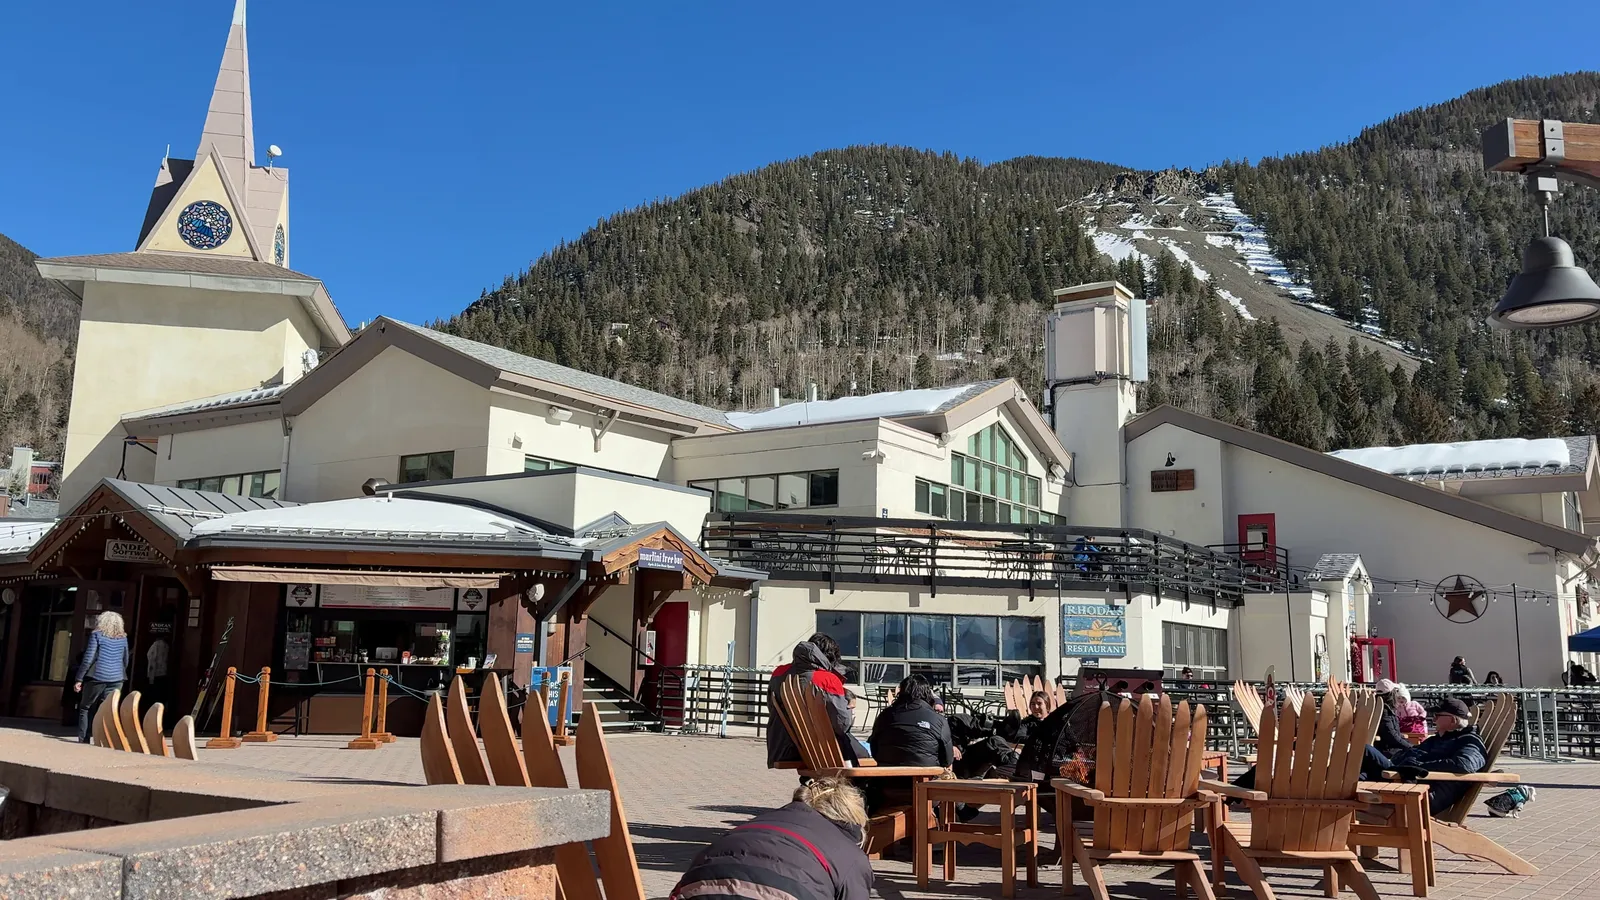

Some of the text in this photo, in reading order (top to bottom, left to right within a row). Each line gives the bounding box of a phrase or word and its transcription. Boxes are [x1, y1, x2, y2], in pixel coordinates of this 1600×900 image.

[112, 543, 150, 551] ANDEA
[640, 551, 662, 562] martini
[673, 554, 683, 565] bar
[1067, 644, 1126, 654] RESTAURANT
[548, 690, 559, 698] HIS
